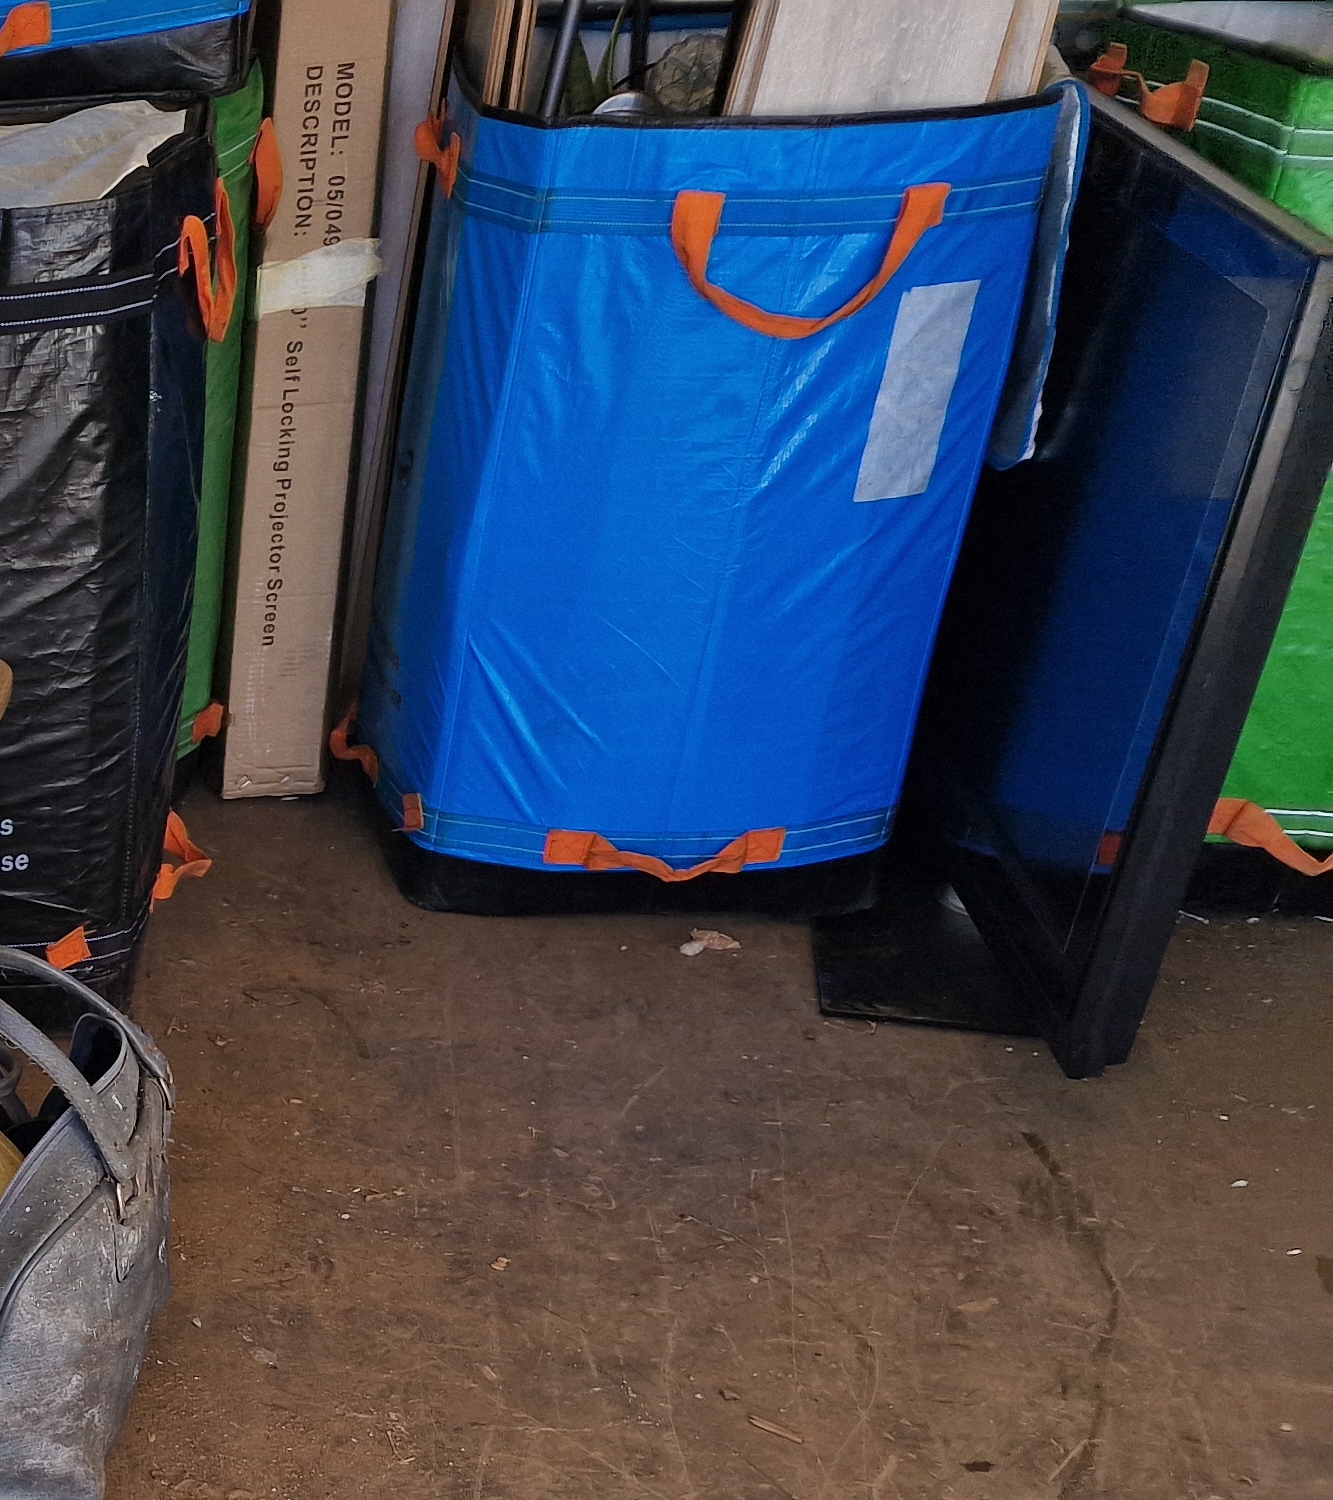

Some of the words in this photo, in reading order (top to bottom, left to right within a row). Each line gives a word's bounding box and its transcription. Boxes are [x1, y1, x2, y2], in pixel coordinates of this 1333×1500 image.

[294, 66, 323, 237] DESCRIPTION:
[331, 62, 355, 156] MODEL:
[286, 341, 303, 383] Self
[273, 389, 299, 472] Locking
[268, 478, 292, 573] Projector
[261, 578, 283, 647] Screen
